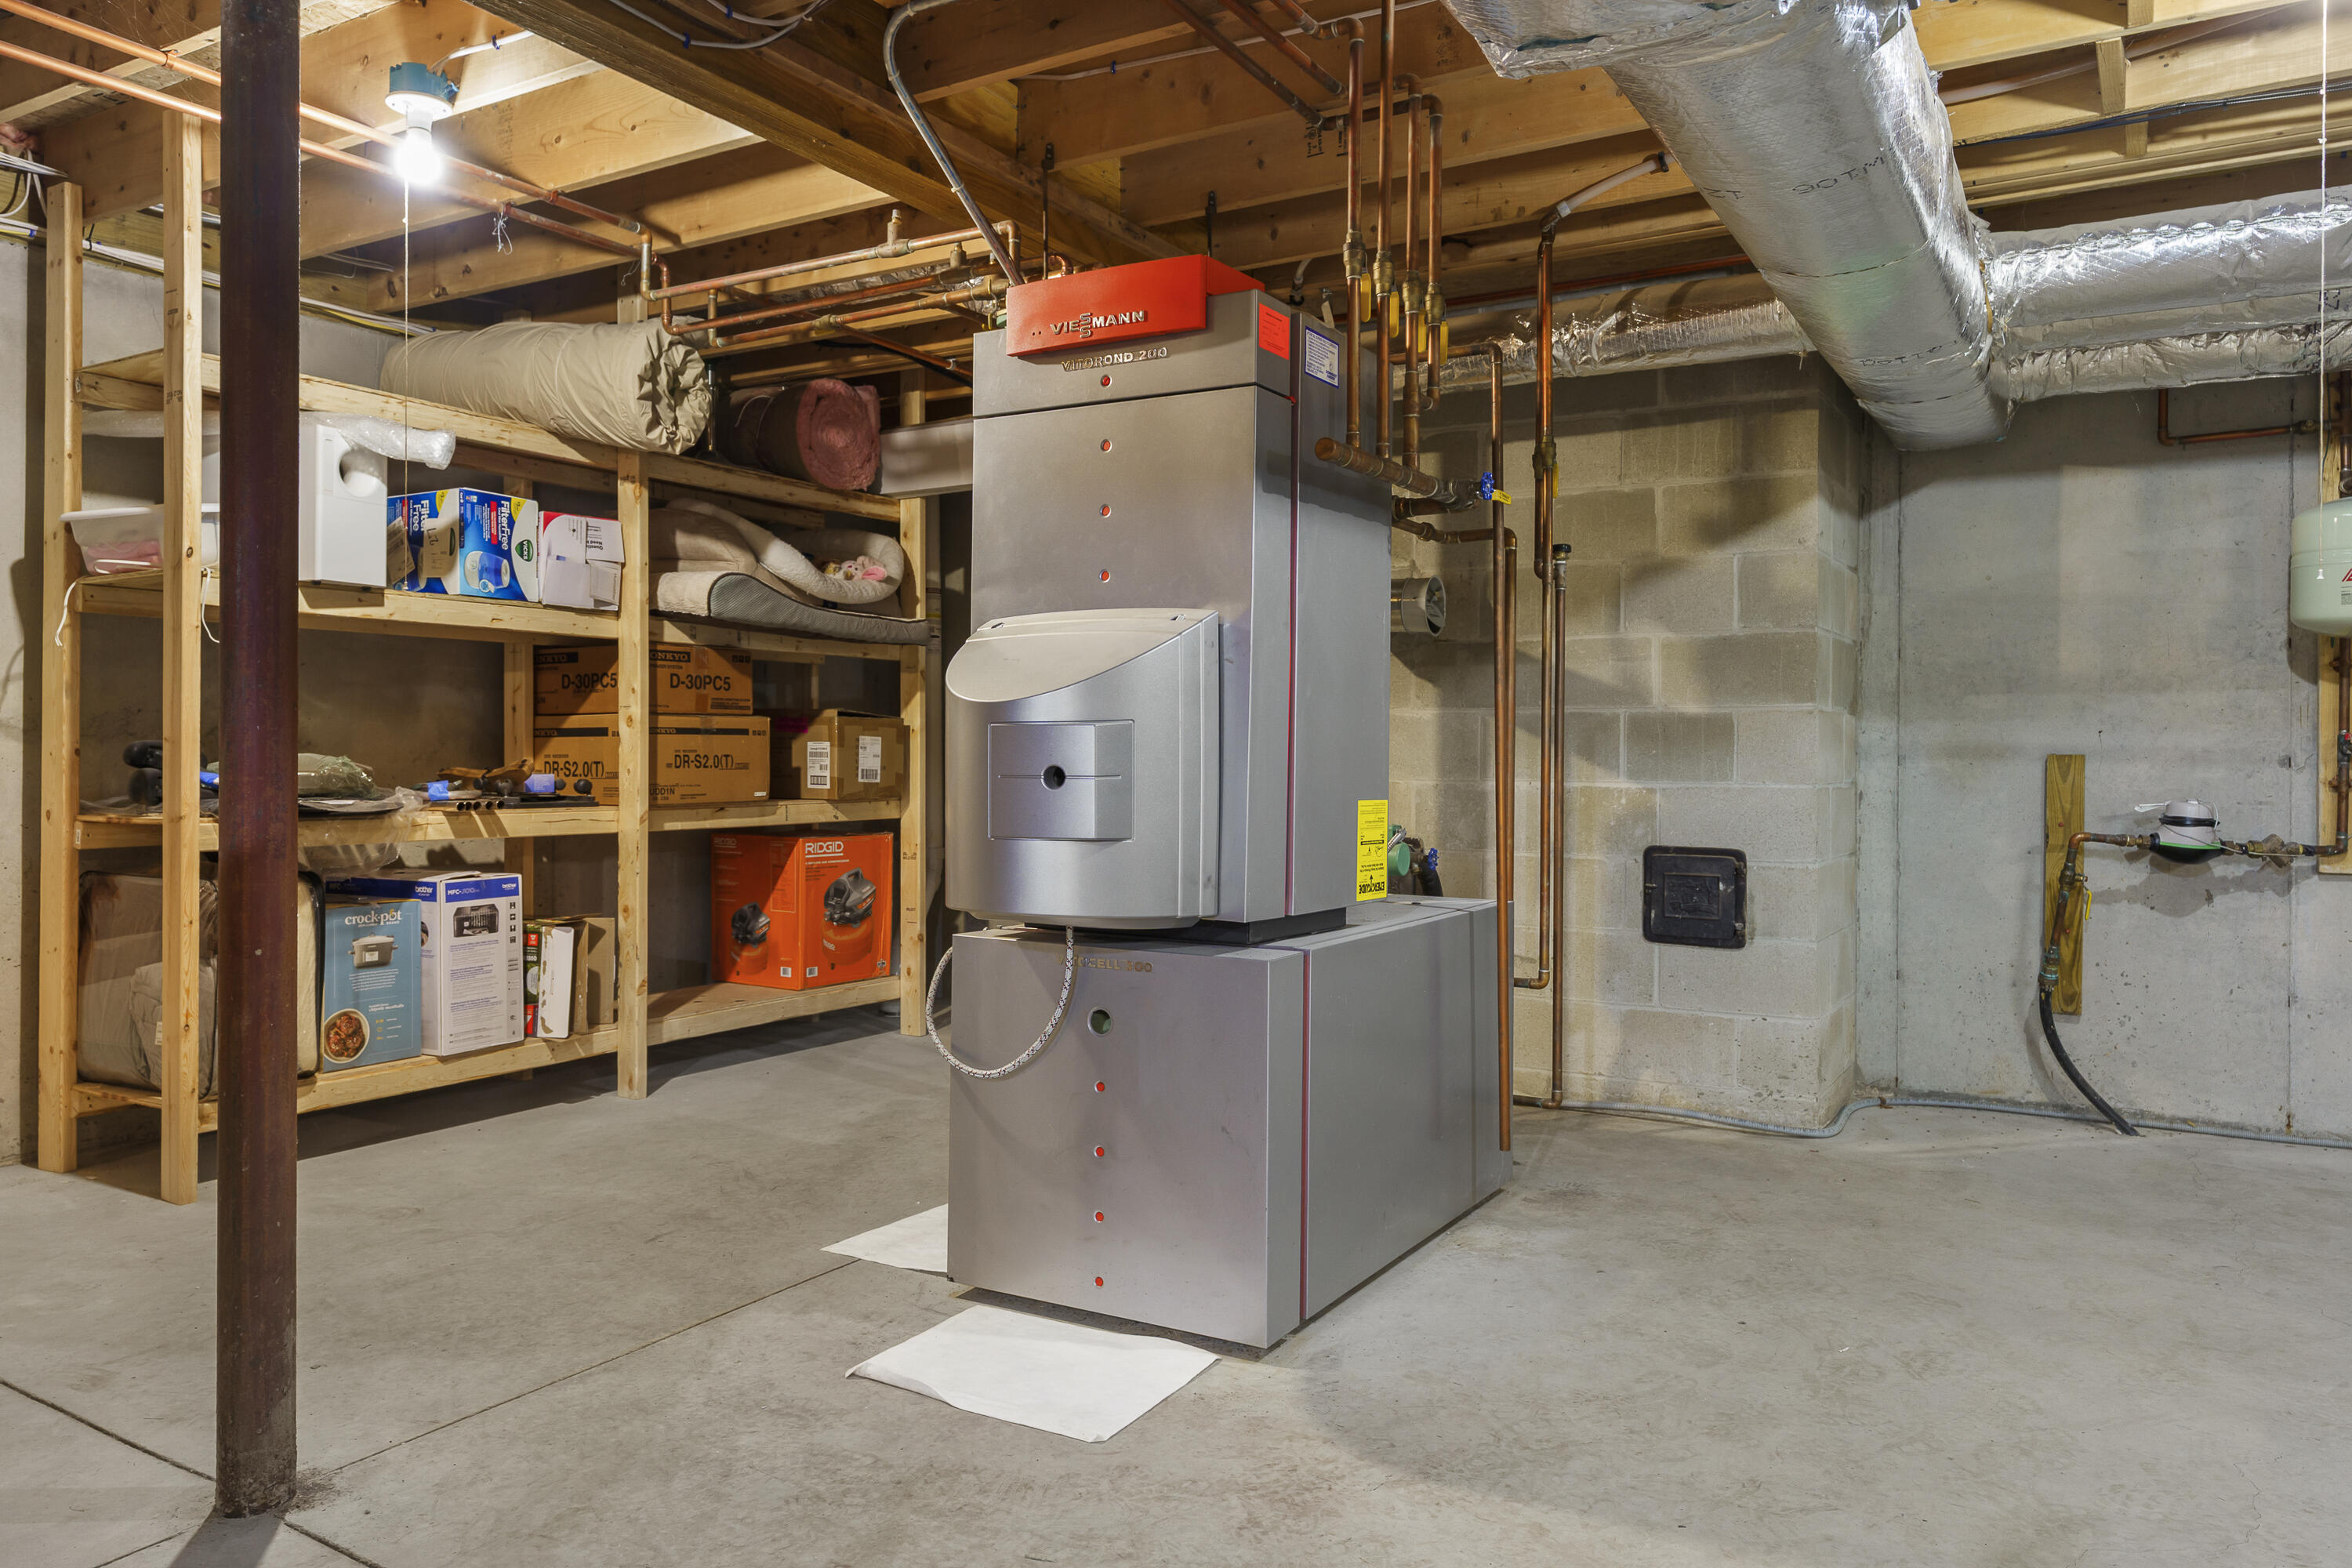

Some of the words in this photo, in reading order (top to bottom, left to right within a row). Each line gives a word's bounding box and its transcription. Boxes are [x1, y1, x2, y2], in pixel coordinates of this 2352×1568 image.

[1050, 310, 1145, 338] VIESSMANN
[1062, 352, 1134, 372] VITOROND
[1138, 347, 1167, 361] 200
[412, 504, 421, 532] Free
[501, 500, 510, 550] FilterFree
[651, 652, 688, 661] ONKYO
[561, 673, 617, 689] D-30PC5
[670, 673, 731, 691] D-30PC5
[544, 760, 604, 778] DR-S2.0(T)
[674, 754, 734, 769] DR-S2.0(T)
[805, 841, 844, 854] RIDGID
[415, 885, 433, 894] brother
[1054, 953, 1121, 971] VTOCELL
